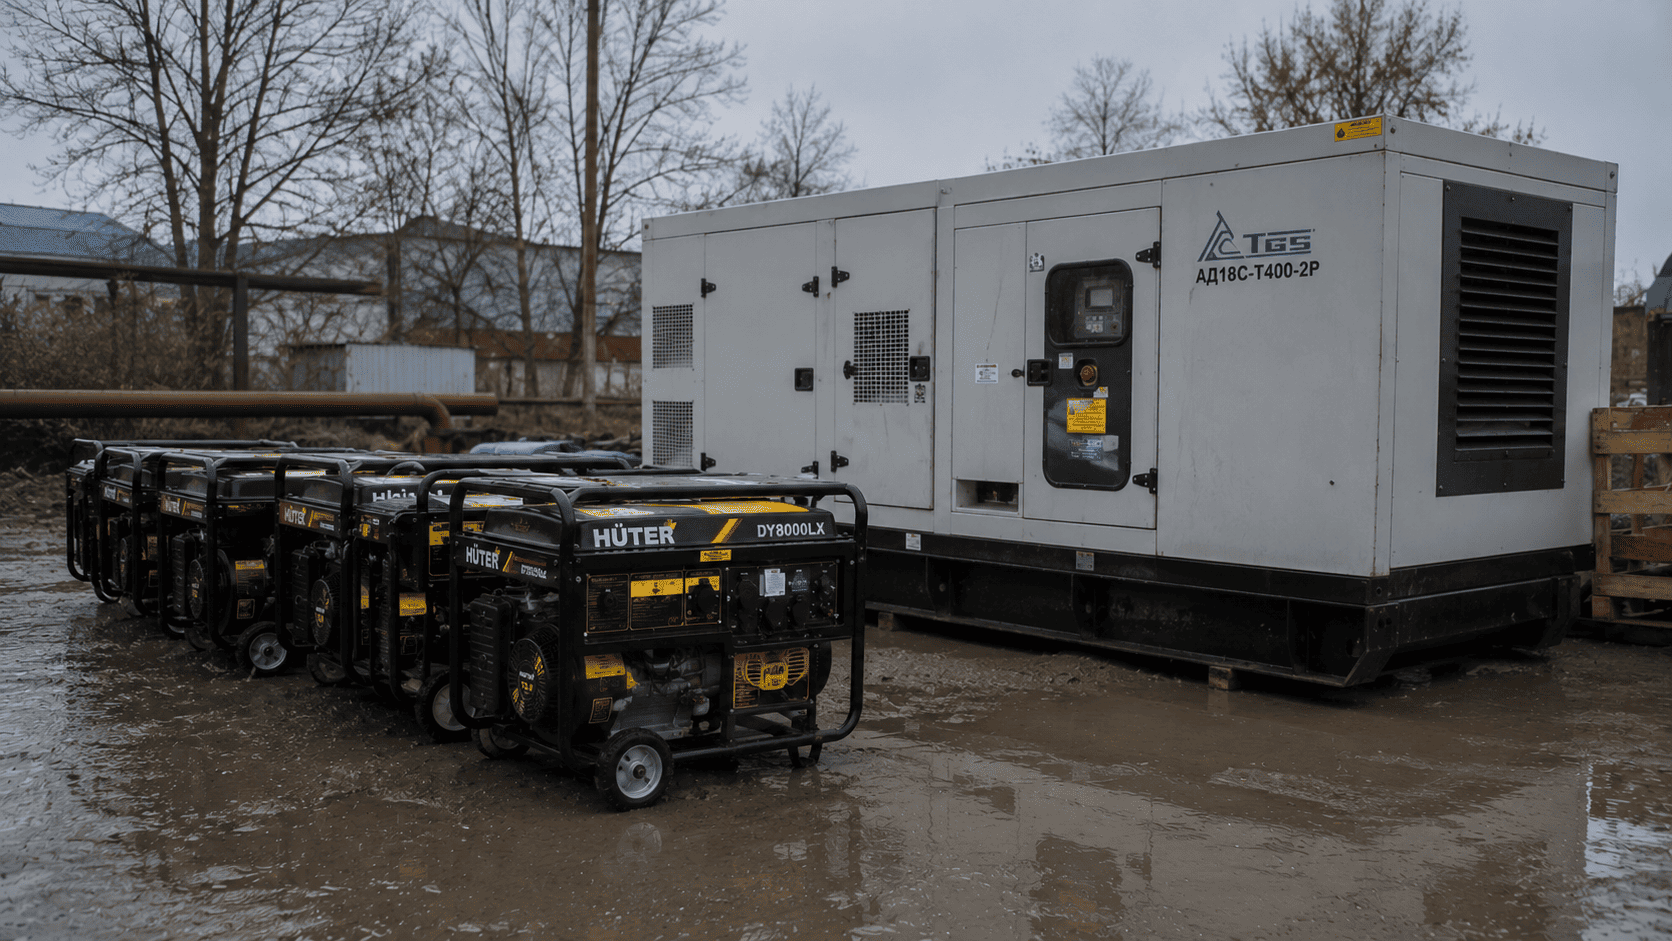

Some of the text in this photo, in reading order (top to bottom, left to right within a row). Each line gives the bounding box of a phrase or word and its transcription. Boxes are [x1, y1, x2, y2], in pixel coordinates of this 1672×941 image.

[593, 522, 676, 548] HÜTER
[757, 522, 826, 538] DY8000LX
[465, 543, 500, 570] HÜTER
